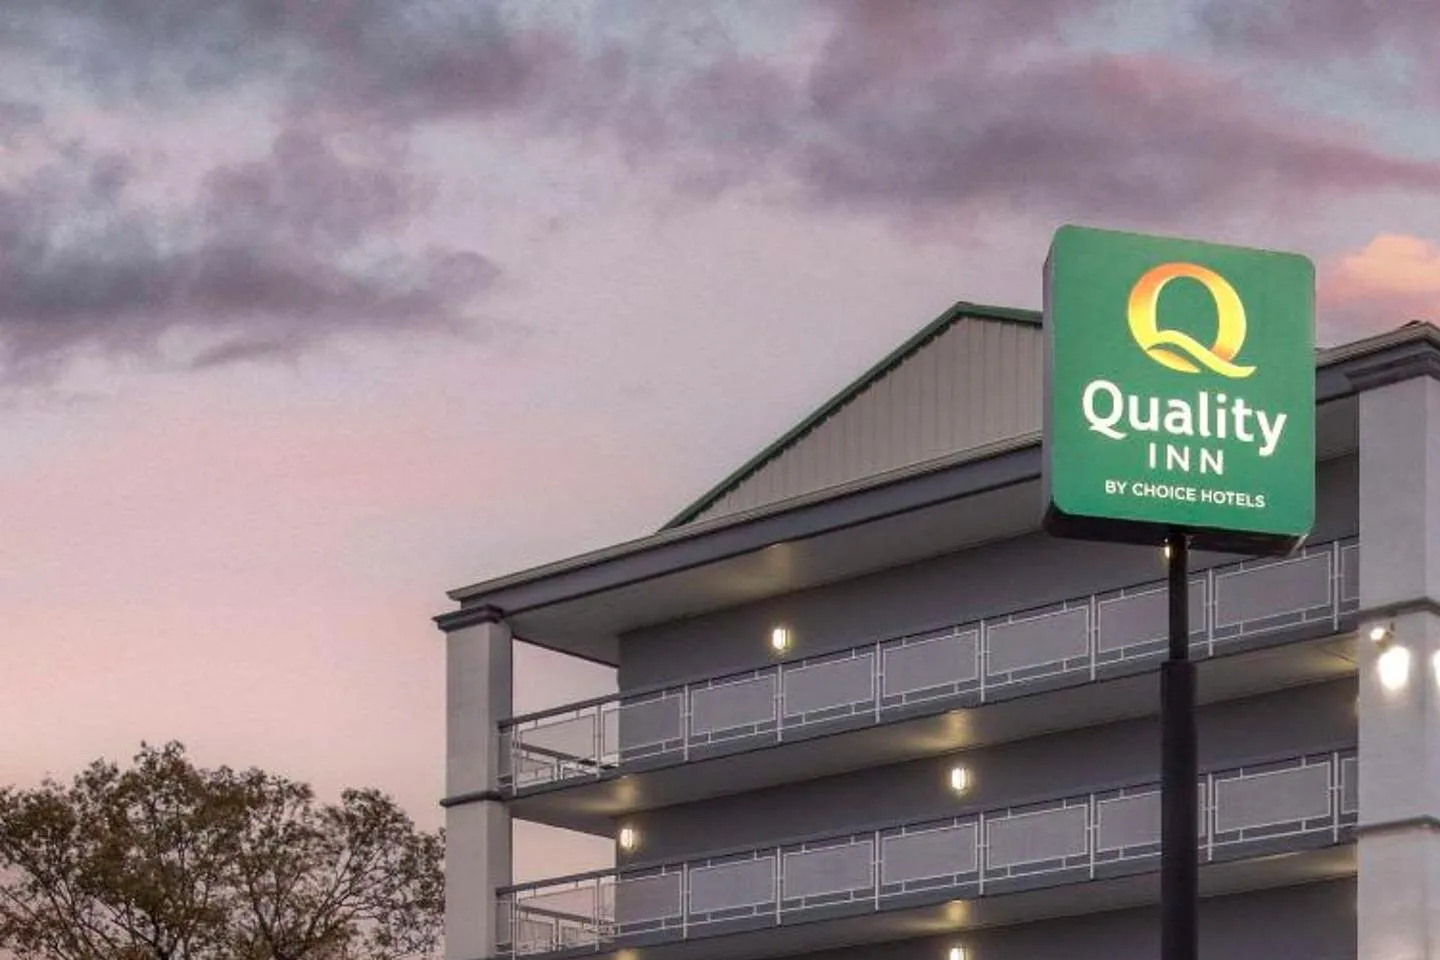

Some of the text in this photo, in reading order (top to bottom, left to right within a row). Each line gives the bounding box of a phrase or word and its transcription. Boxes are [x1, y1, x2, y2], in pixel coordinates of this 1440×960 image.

[1128, 262, 1256, 379] Q
[1082, 379, 1287, 457] Quality
[1149, 442, 1224, 476] INN
[1105, 480, 1267, 508] BY CHOICE HOTELS
